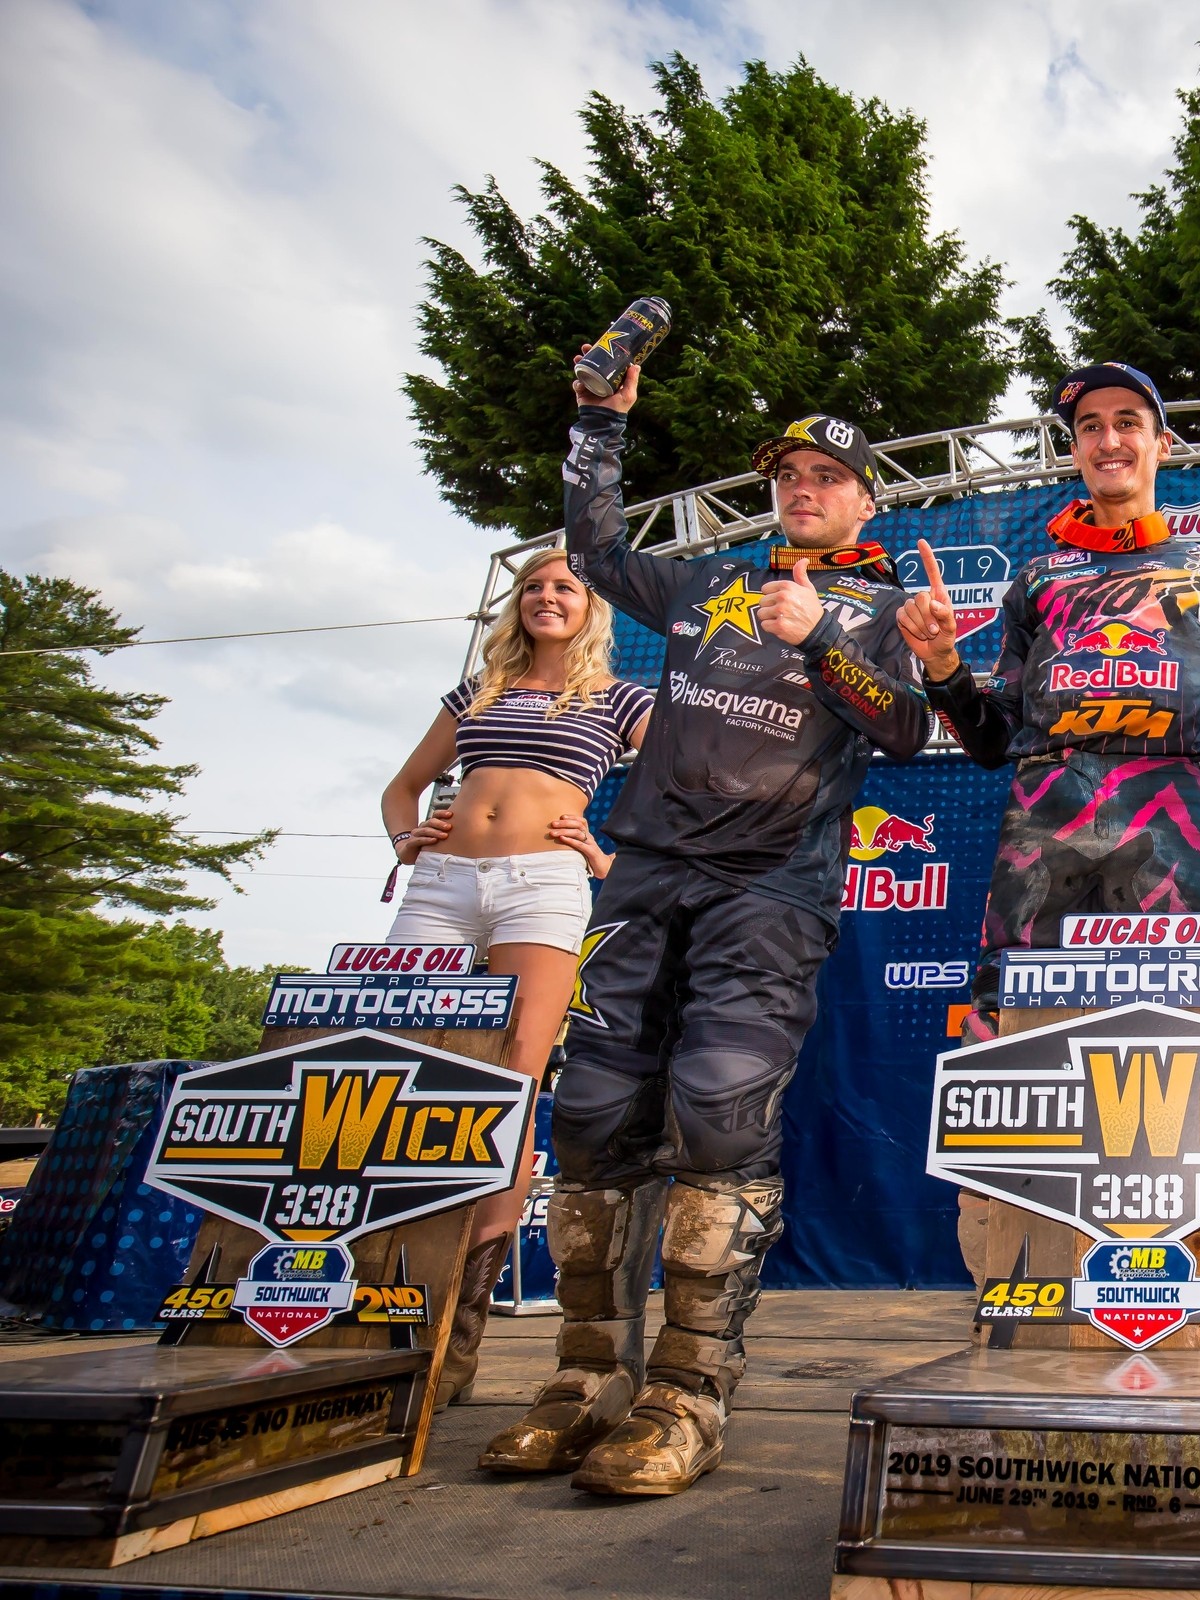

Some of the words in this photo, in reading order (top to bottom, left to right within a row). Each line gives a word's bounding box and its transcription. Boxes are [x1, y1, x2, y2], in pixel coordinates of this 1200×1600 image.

[1053, 553, 1085, 566] 100%
[825, 593, 874, 615] MOTOREX
[1050, 659, 1113, 692] Red
[1115, 660, 1180, 692] Bull
[682, 681, 803, 729] Husqvarna
[726, 718, 763, 731] FACTORY
[764, 726, 795, 742] RACING
[1049, 699, 1174, 739] KTM
[862, 863, 949, 912] Bull
[1068, 917, 1171, 945] LUCAS
[334, 947, 423, 972] LUCAS
[422, 947, 464, 972] OIL
[1109, 949, 1182, 960] PRO
[364, 976, 426, 986] PRO
[885, 961, 969, 989] WPS
[268, 987, 510, 1015] MOTOCROSS
[265, 1014, 504, 1028] CHAMPIONSHIP
[274, 1184, 359, 1227] 338
[1092, 1174, 1184, 1220] 338
[291, 1249, 328, 1270] MB
[1130, 1247, 1167, 1269] MB
[164, 1287, 235, 1309] 450
[353, 1286, 424, 1323] 2ND
[254, 1286, 332, 1303] SOUTHWICK
[982, 1283, 1066, 1307] 450
[1096, 1286, 1180, 1304] SOUTHWICK
[159, 1308, 204, 1318] CLASS
[388, 1307, 424, 1316] PLACE
[256, 1310, 320, 1319] NATIONAL
[981, 1306, 1033, 1317] CLASS
[1103, 1313, 1174, 1321] NATIONAL
[253, 1407, 289, 1435] NO
[292, 1388, 390, 1427] HIGHWAY
[888, 1451, 951, 1477] 2019
[957, 1455, 1115, 1486] SOUTHWICK
[956, 1486, 1004, 1504] JUNE
[1052, 1490, 1099, 1510] 2019
[1169, 1496, 1181, 1513] 6
